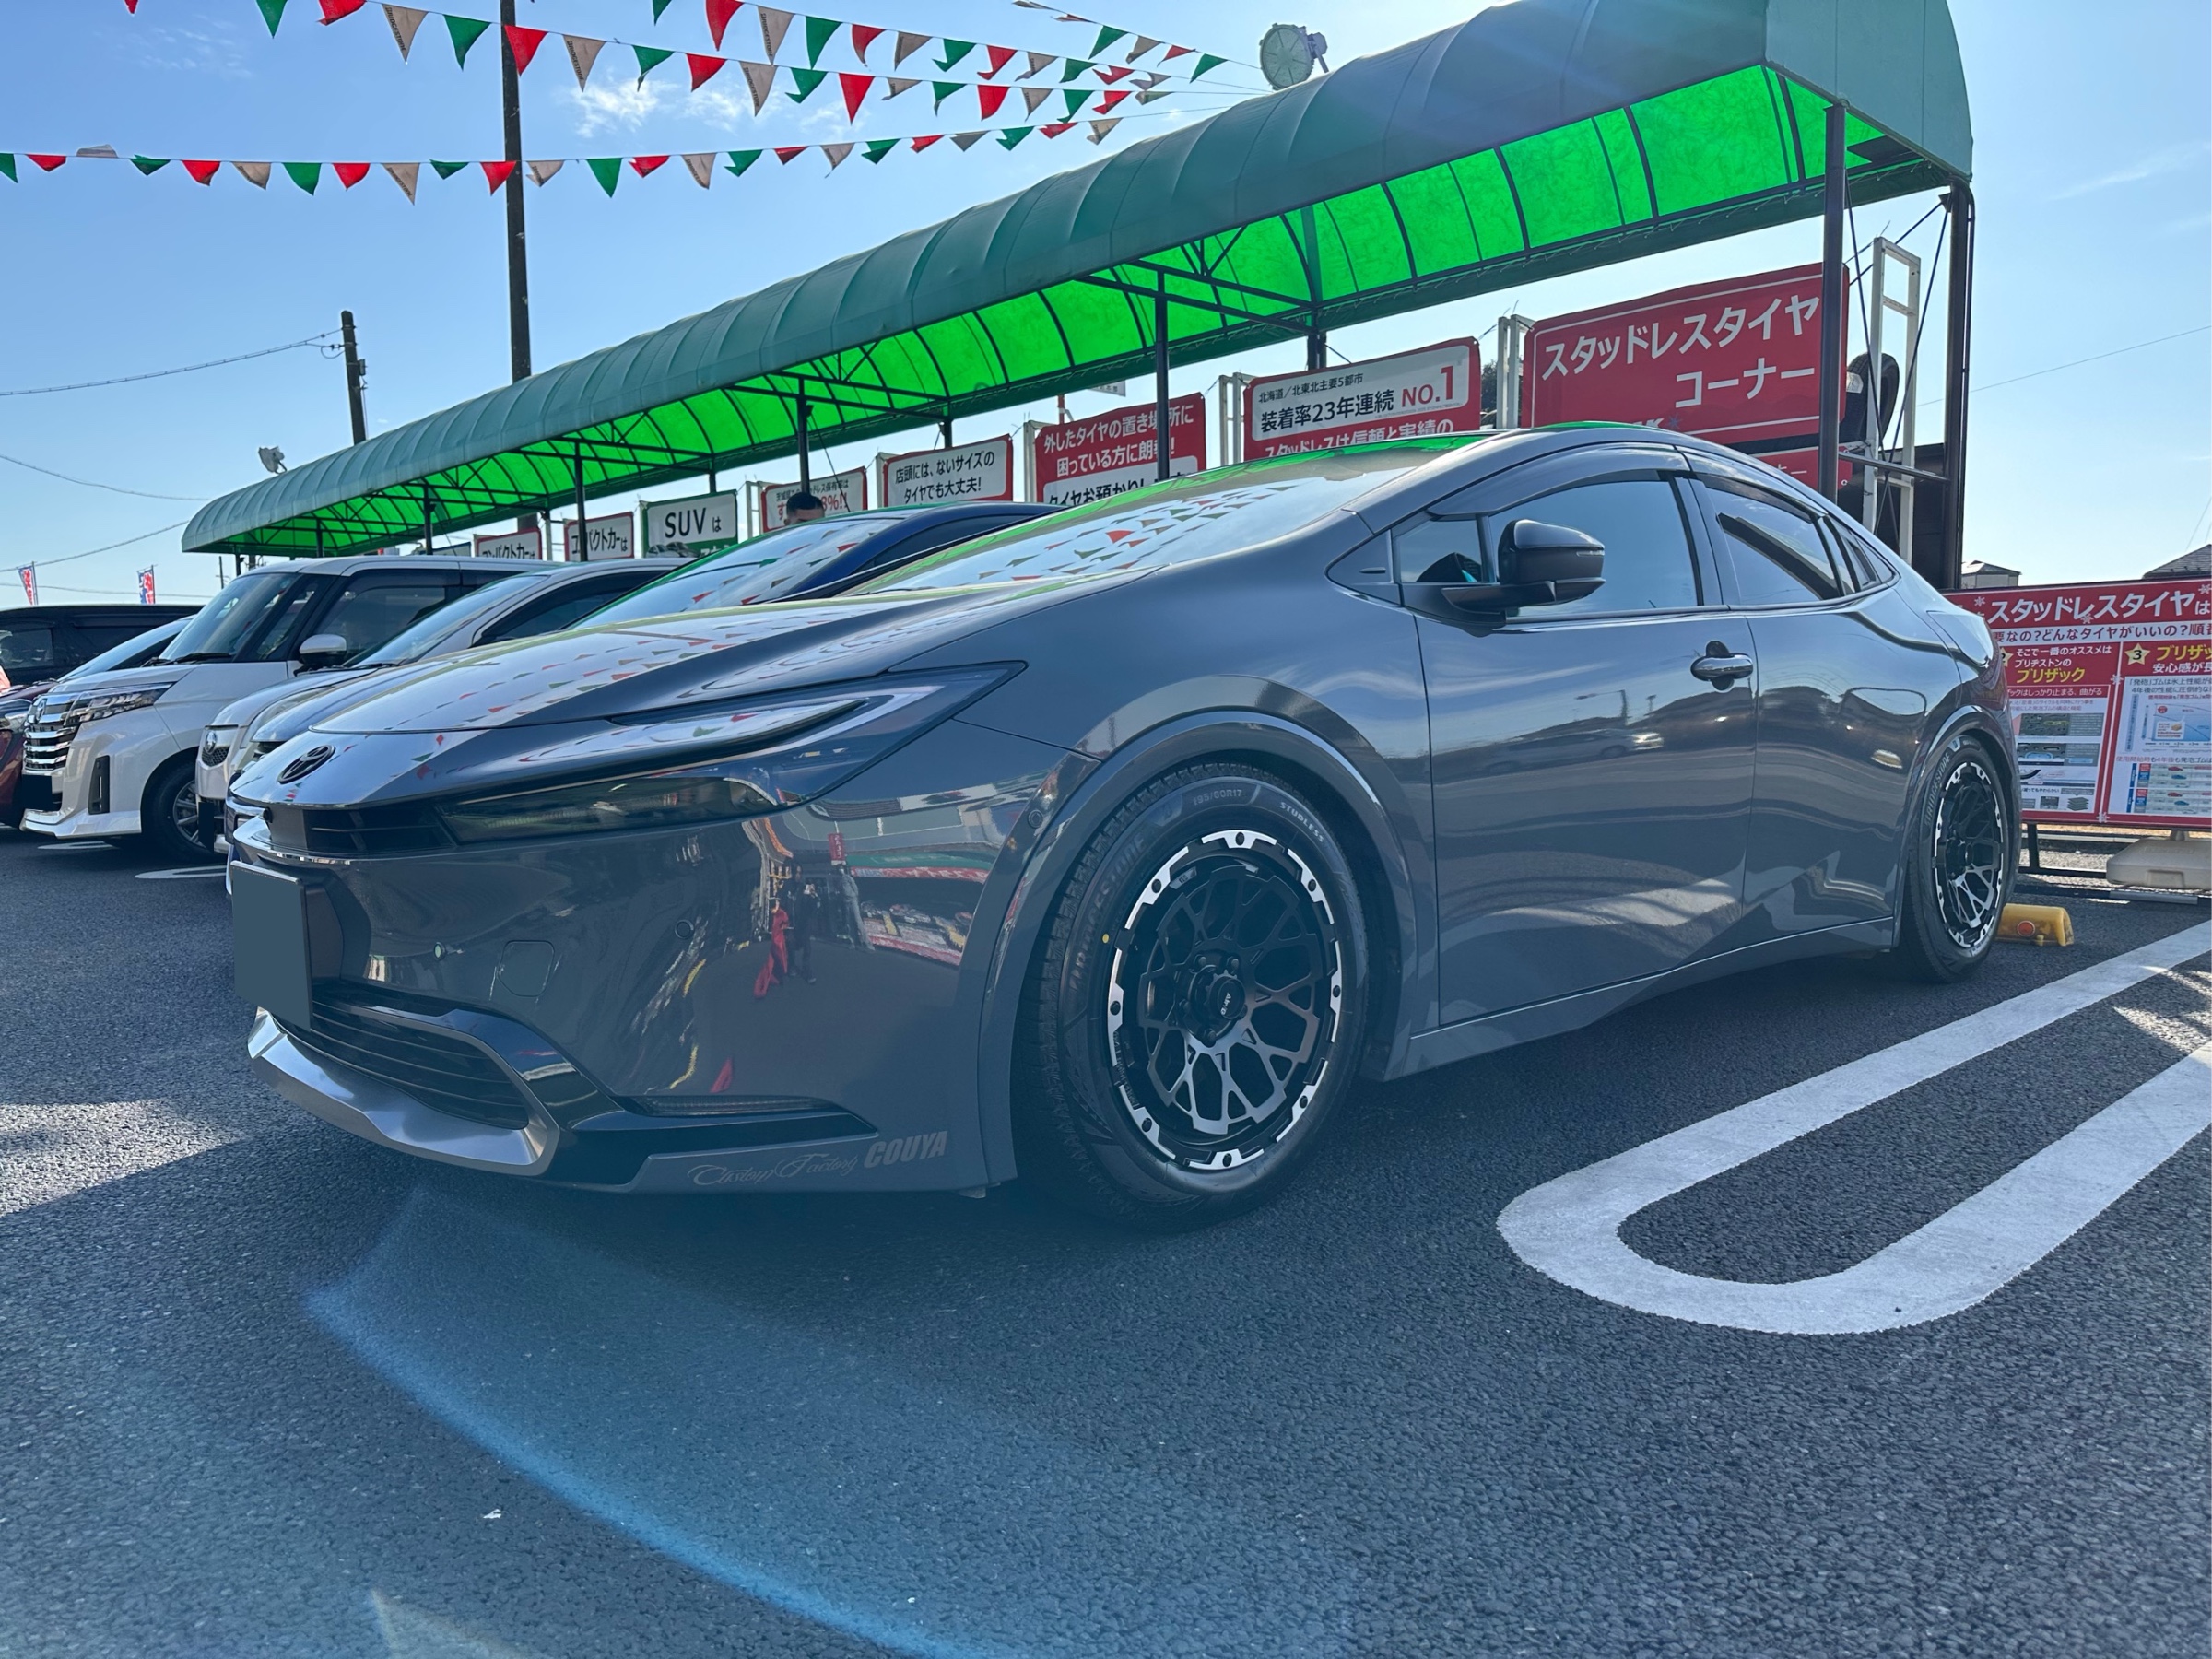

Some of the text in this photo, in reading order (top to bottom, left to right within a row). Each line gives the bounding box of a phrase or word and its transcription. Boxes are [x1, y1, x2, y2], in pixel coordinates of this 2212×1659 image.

[1542, 294, 1820, 382] スタッドレスタイヤ
[1675, 358, 1816, 408] コーナー
[1261, 365, 1454, 433] 装着率23年連続 NO.1
[895, 451, 995, 484] 店頭には、ないサイズの
[903, 477, 982, 504] タイヤでも大丈夫!
[665, 508, 722, 538] SUV は
[1987, 590, 2211, 624] スタッドレスタイヤは
[2017, 645, 2112, 657] そこで一番のオススメは
[2132, 649, 2143, 661] 3
[2016, 667, 2086, 684] ブリザック
[2007, 688, 2103, 697] ックはしっかり止まる、曲がる
[1193, 789, 1242, 806] 195/60R17
[1279, 801, 1324, 842] STUDLESS
[688, 1164, 776, 1185] Custom
